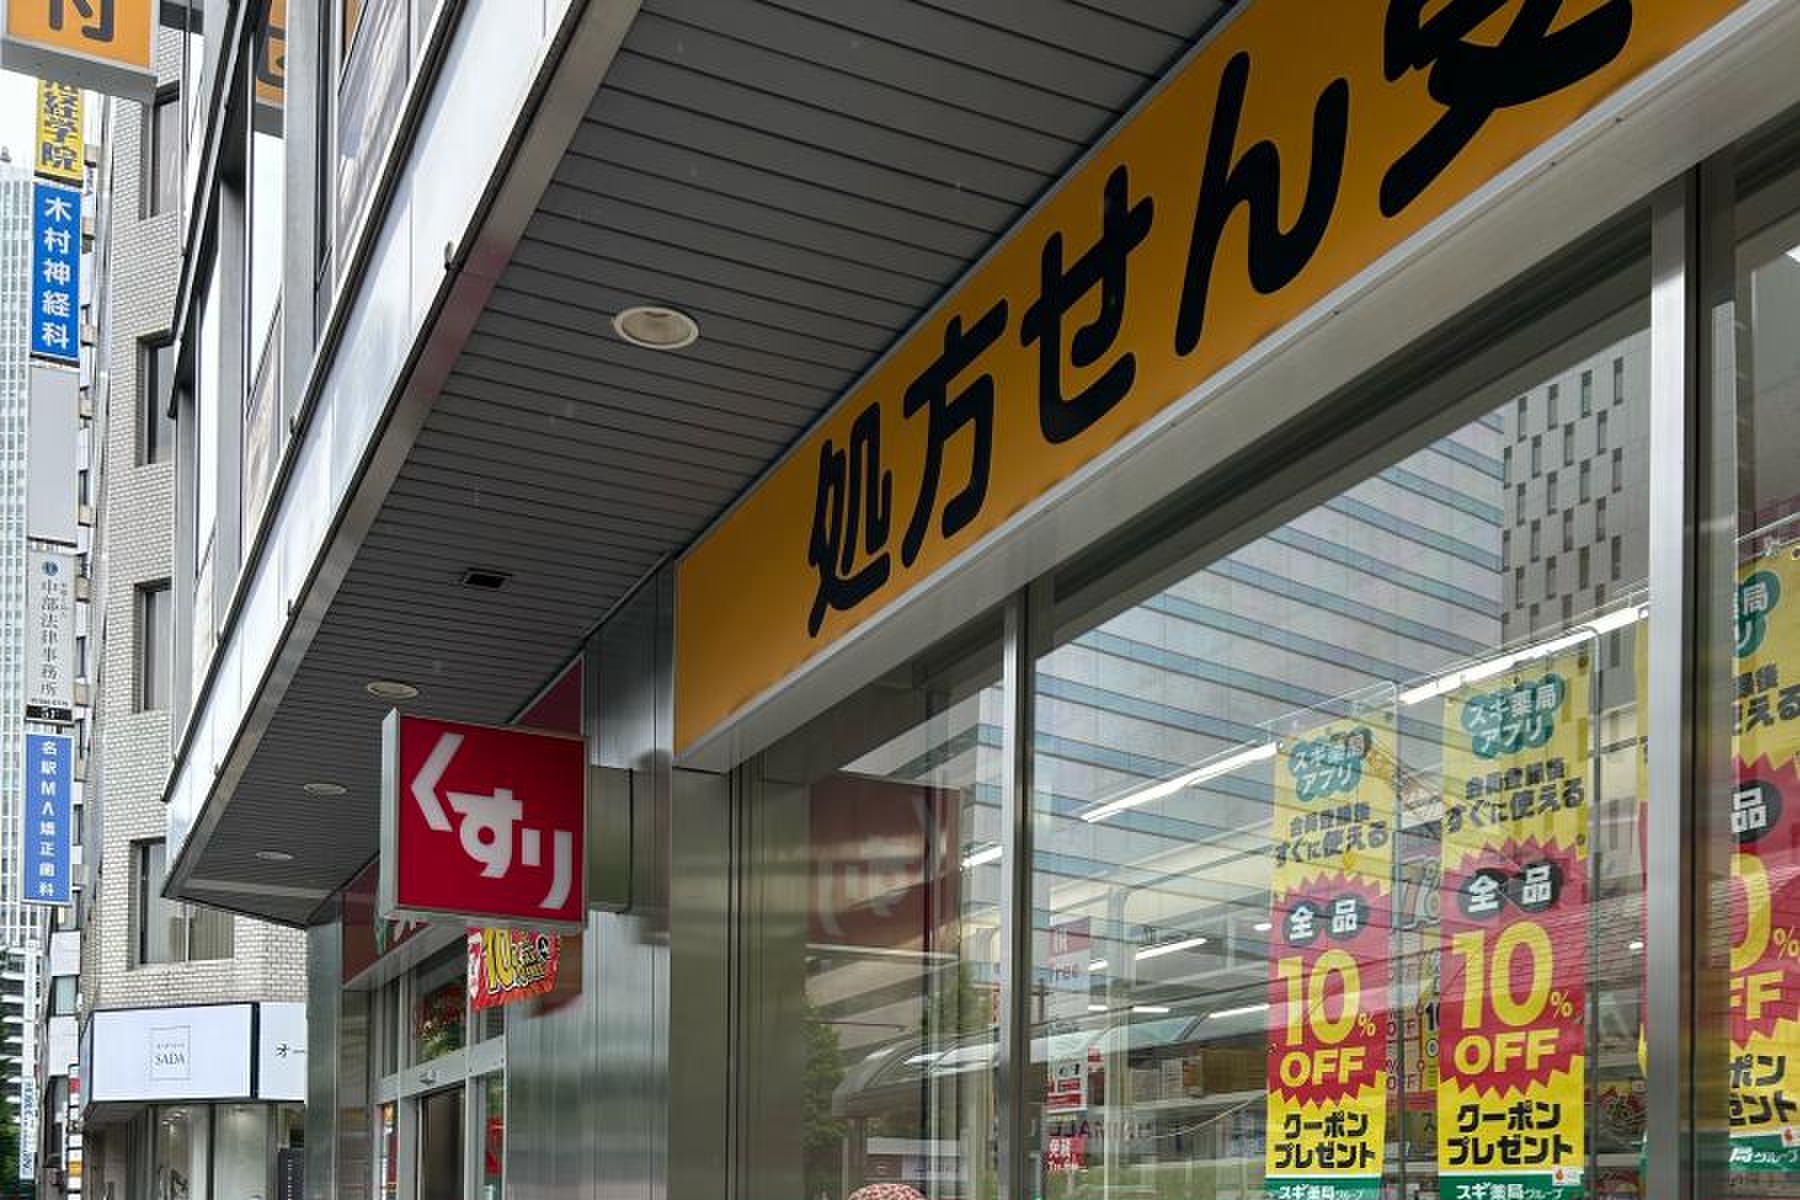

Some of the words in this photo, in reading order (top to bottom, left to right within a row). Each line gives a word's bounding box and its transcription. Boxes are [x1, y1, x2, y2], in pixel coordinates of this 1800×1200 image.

[41, 196, 73, 350] 木村神経科
[1478, 716, 1543, 754] アプリ
[1299, 766, 1352, 795] アプリ
[411, 732, 573, 911] くすり
[1442, 777, 1585, 834] すぐに使える
[1467, 864, 1552, 913] 全品
[1289, 898, 1358, 941] 全品
[154, 1053, 186, 1066] SADA
[1279, 1046, 1367, 1088] OFF
[1454, 1028, 1560, 1075] OFF
[1283, 1110, 1369, 1140] クーポン
[1457, 1099, 1561, 1133] クーポン
[1275, 1142, 1376, 1169] プレゼント
[1447, 1133, 1573, 1165] プレゼント
